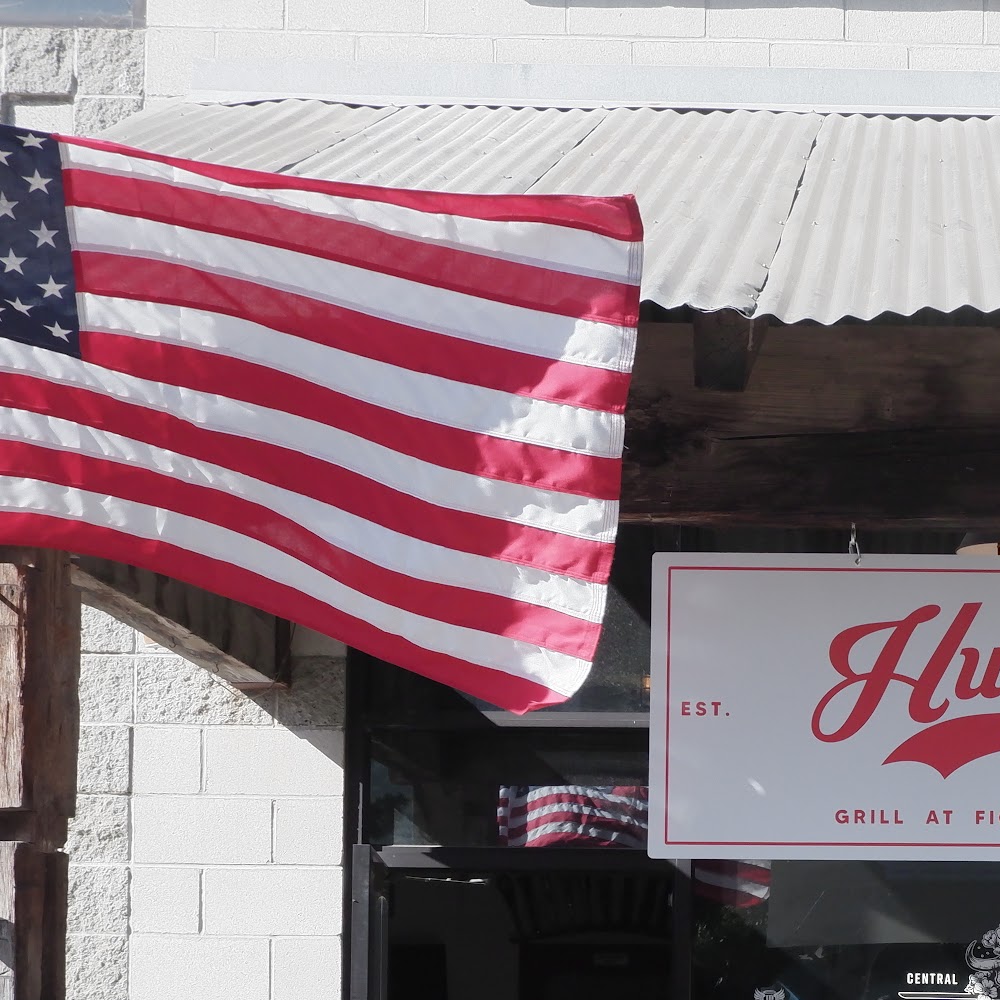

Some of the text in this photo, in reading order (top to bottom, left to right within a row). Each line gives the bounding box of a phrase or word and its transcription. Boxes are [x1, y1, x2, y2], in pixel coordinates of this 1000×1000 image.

[680, 701, 731, 716] EST.
[834, 809, 903, 825] GRILL
[925, 809, 953, 825] AT
[906, 972, 958, 985] CENTRAL
